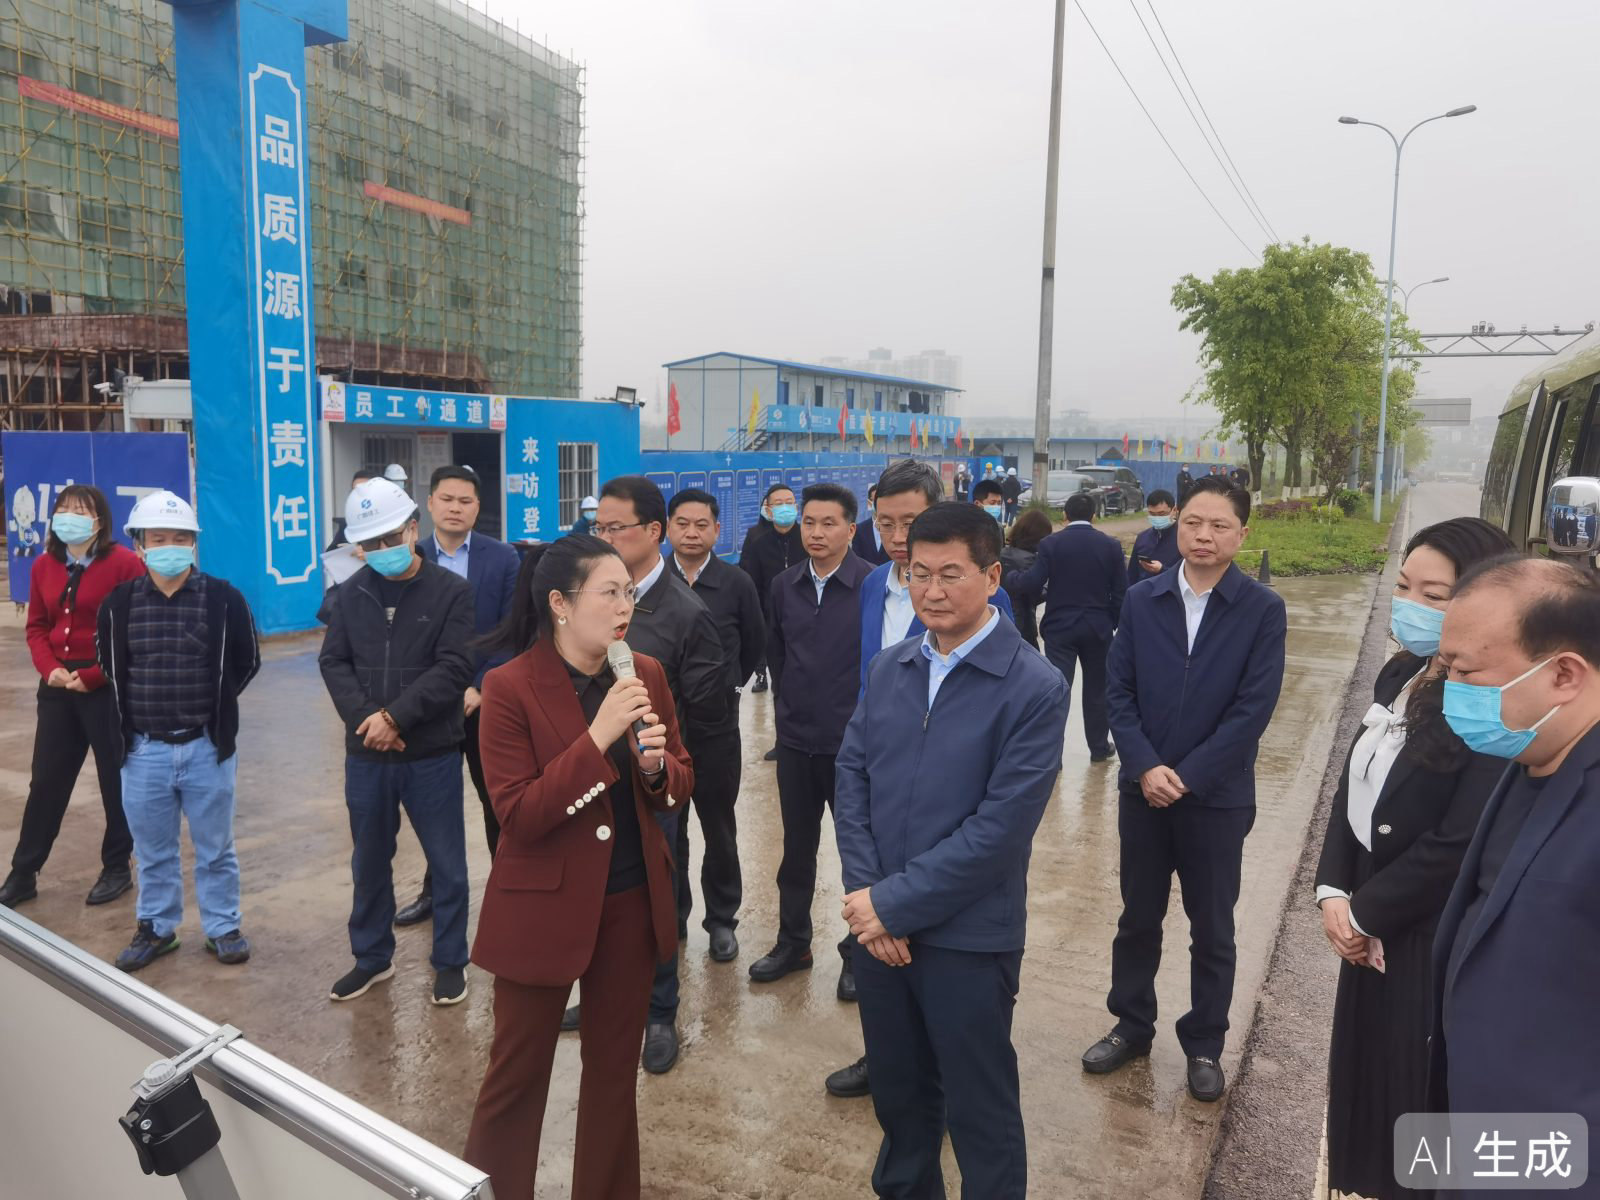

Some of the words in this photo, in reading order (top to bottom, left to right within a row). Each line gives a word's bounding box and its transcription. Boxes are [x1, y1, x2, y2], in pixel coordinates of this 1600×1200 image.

[260, 113, 309, 541] 品质源于责任
[355, 391, 484, 424] 员工通道
